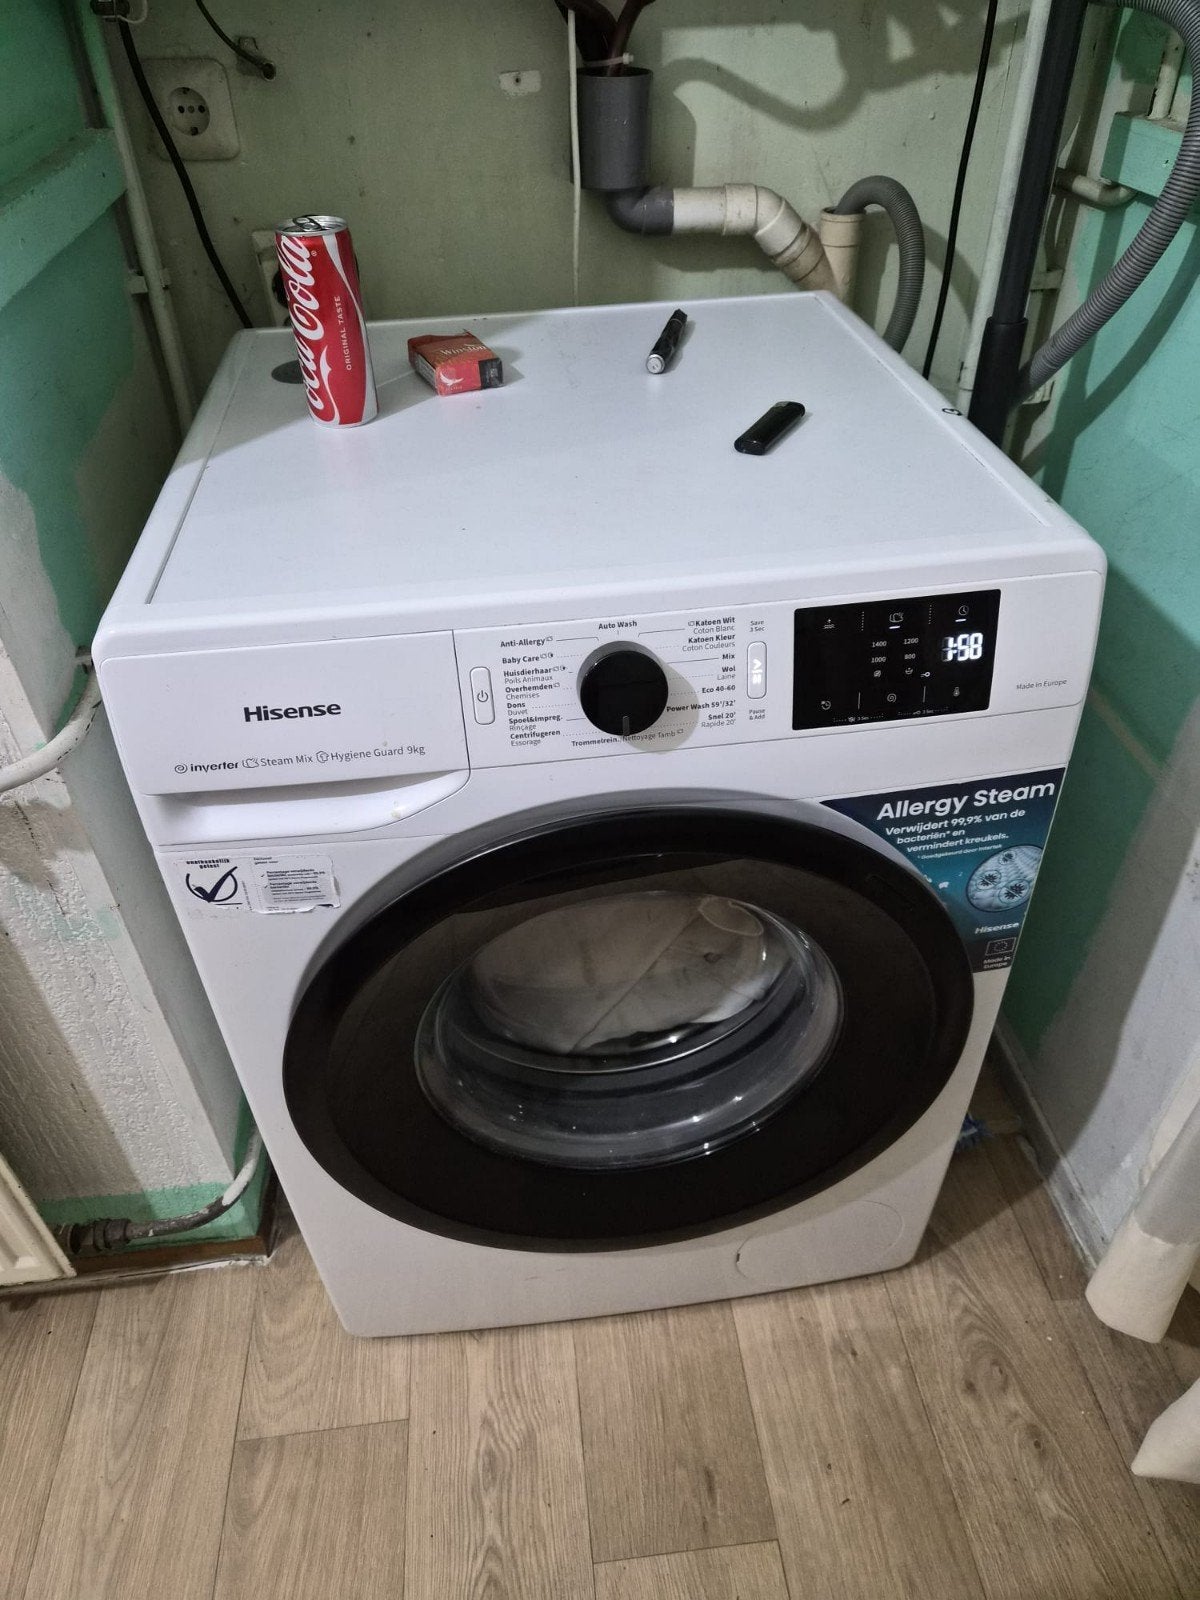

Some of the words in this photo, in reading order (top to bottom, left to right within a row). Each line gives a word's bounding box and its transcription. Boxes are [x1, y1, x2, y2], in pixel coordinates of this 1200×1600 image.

[333, 295, 345, 325] TASTE
[341, 327, 352, 371] ORIGINAL
[440, 343, 487, 355] Winston
[617, 620, 638, 628] Wash
[696, 618, 722, 627] Katoen
[722, 616, 735, 624] Wit
[693, 626, 714, 635] Coton
[715, 625, 735, 633] Blanc
[500, 638, 546, 648] Anti-Allergy
[688, 635, 714, 644] Katoen
[715, 633, 736, 641] Kleur
[872, 640, 887, 648] 1400
[903, 637, 919, 645] 1200
[682, 644, 703, 652] Coton
[704, 641, 736, 650] Couleurs
[502, 656, 521, 664] Baby
[522, 655, 540, 663] Care
[871, 656, 887, 664] 1000
[503, 667, 552, 677] Huisdierhaar
[504, 677, 521, 685] Poils
[522, 675, 553, 683] Animaux
[1043, 679, 1067, 688] Europe
[505, 684, 553, 693] Overhemden
[715, 684, 736, 692] 40-60
[506, 692, 540, 700] Chemises
[666, 703, 689, 712] Power
[690, 701, 710, 710] Wash
[243, 703, 342, 723] Hisense
[509, 714, 563, 726] Spoel&Impreg.
[701, 719, 725, 728] Rapide
[509, 724, 537, 732] Rinçage
[510, 730, 561, 739] Centrifugeren
[622, 732, 656, 742] Nettoyage
[511, 739, 541, 747] Essorage
[190, 760, 239, 774] inverter
[260, 755, 294, 768] Steam
[296, 754, 314, 764] Mix
[330, 749, 372, 763] Hygiene
[373, 746, 404, 757] Guard
[406, 744, 426, 757] 9kg
[876, 795, 970, 821] Allergy
[973, 782, 1056, 807] Steam
[885, 820, 949, 836] Verwijdert
[950, 814, 983, 828] 99,9%
[984, 811, 1008, 822] van
[1010, 808, 1026, 818] de
[952, 828, 966, 836] en
[906, 839, 965, 853] vermindert
[965, 832, 1010, 845] kreukels.
[974, 922, 1020, 934] Hisense
